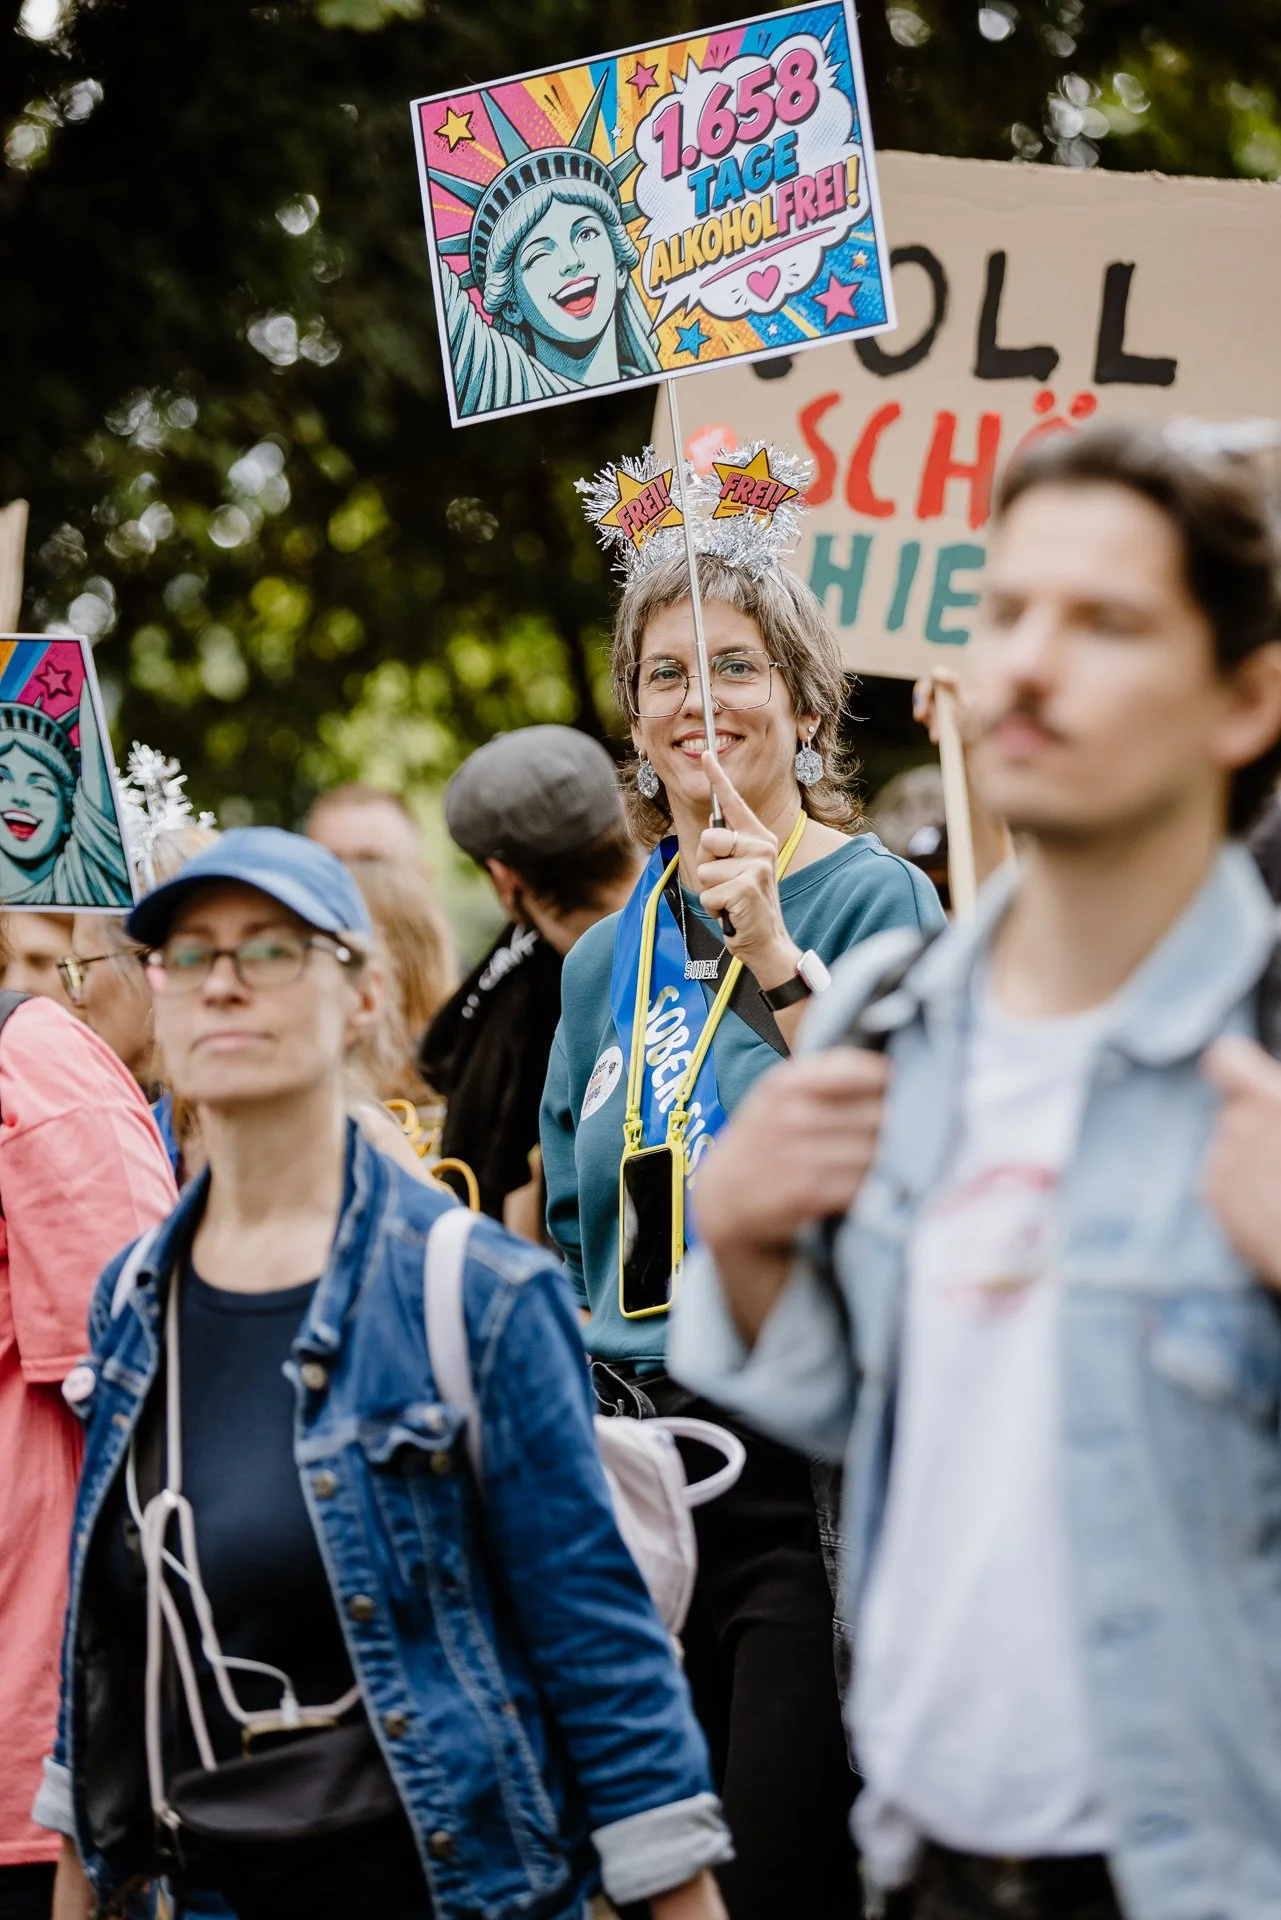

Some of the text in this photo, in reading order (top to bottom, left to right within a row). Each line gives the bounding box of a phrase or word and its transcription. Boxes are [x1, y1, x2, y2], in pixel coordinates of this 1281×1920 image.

[651, 47, 820, 181] 1.658
[687, 130, 799, 217] TAGE
[749, 245, 1178, 386] OLL
[615, 474, 673, 540] FREI!
[718, 471, 791, 513] FREI!
